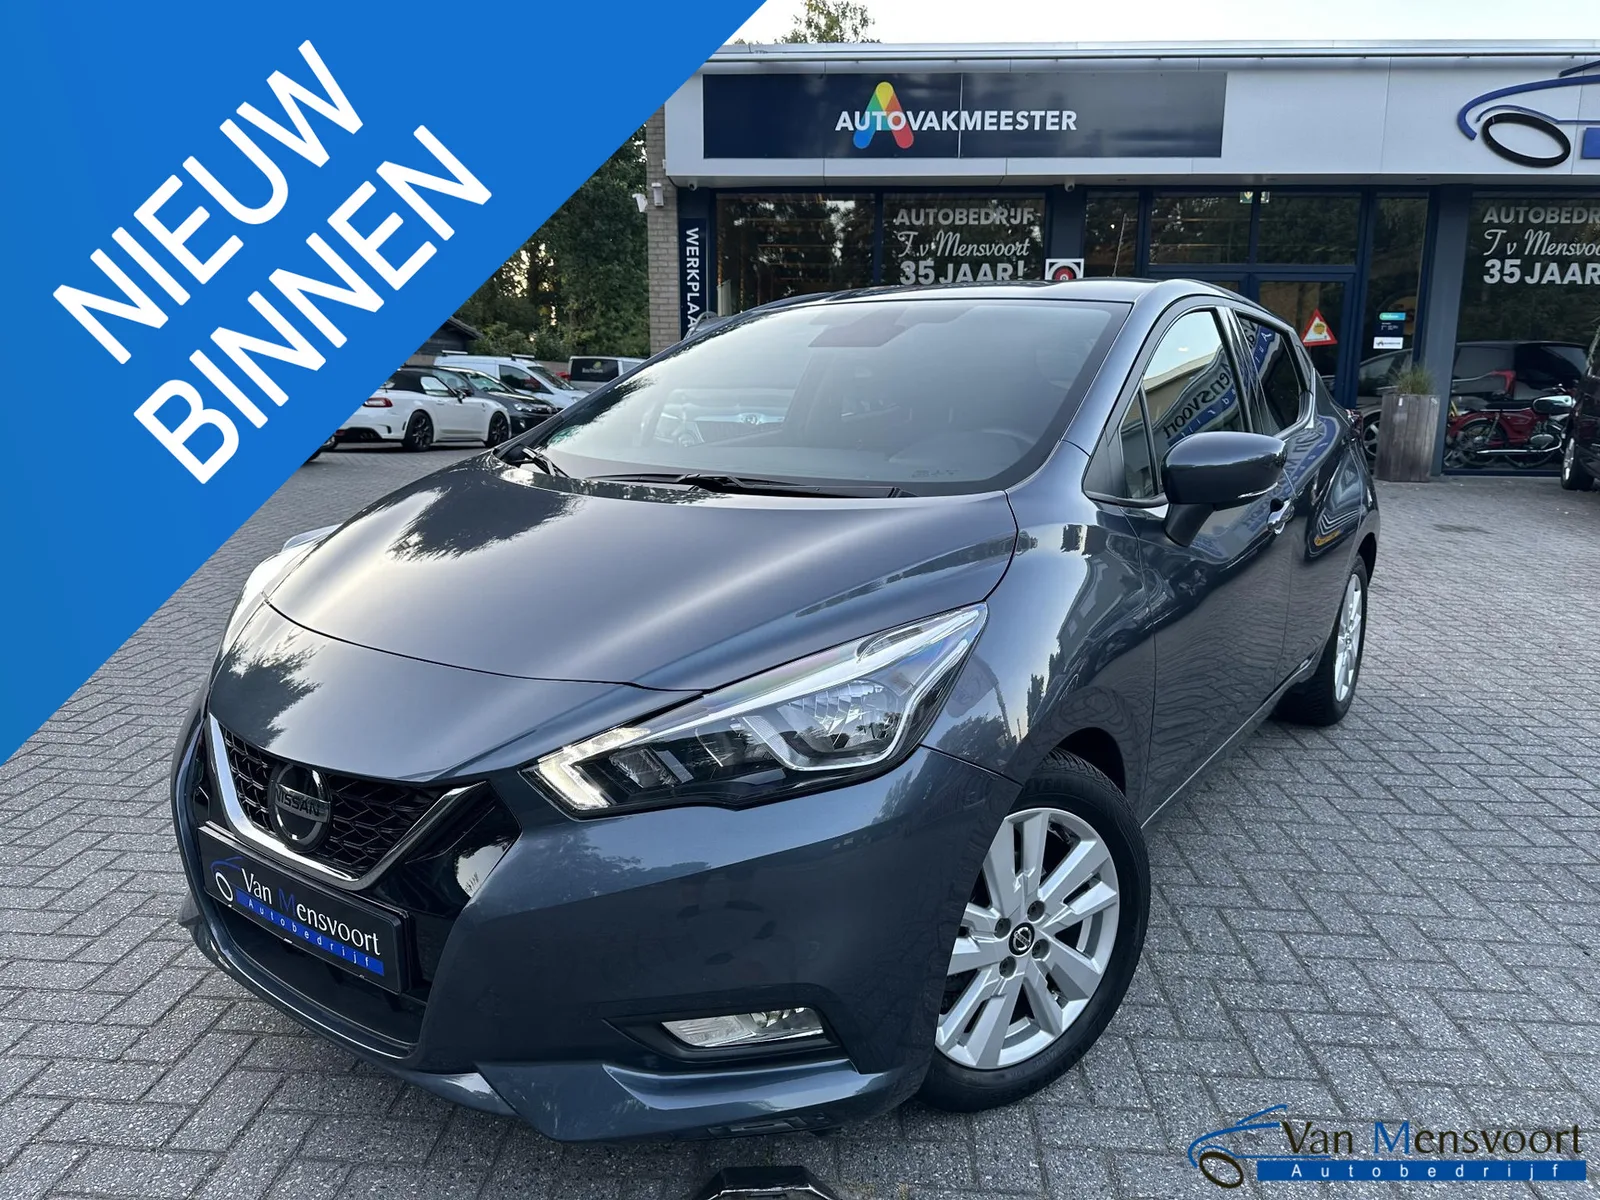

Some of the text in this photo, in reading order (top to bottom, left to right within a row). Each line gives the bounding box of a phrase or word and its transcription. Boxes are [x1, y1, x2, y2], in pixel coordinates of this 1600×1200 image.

[835, 110, 1078, 132] AUTOVAKMEESTER
[895, 207, 1035, 226] AUTOBEDRIJF
[1482, 206, 1600, 224] AUTOBEDR
[936, 228, 1031, 257] Mensvoort
[900, 260, 1025, 286] 35 JAAR!
[1483, 258, 1600, 285] 35 JAAR
[275, 785, 320, 816] NISSAN
[241, 867, 381, 956] Van Mensvoort
[248, 900, 371, 968] Autobedrijf
